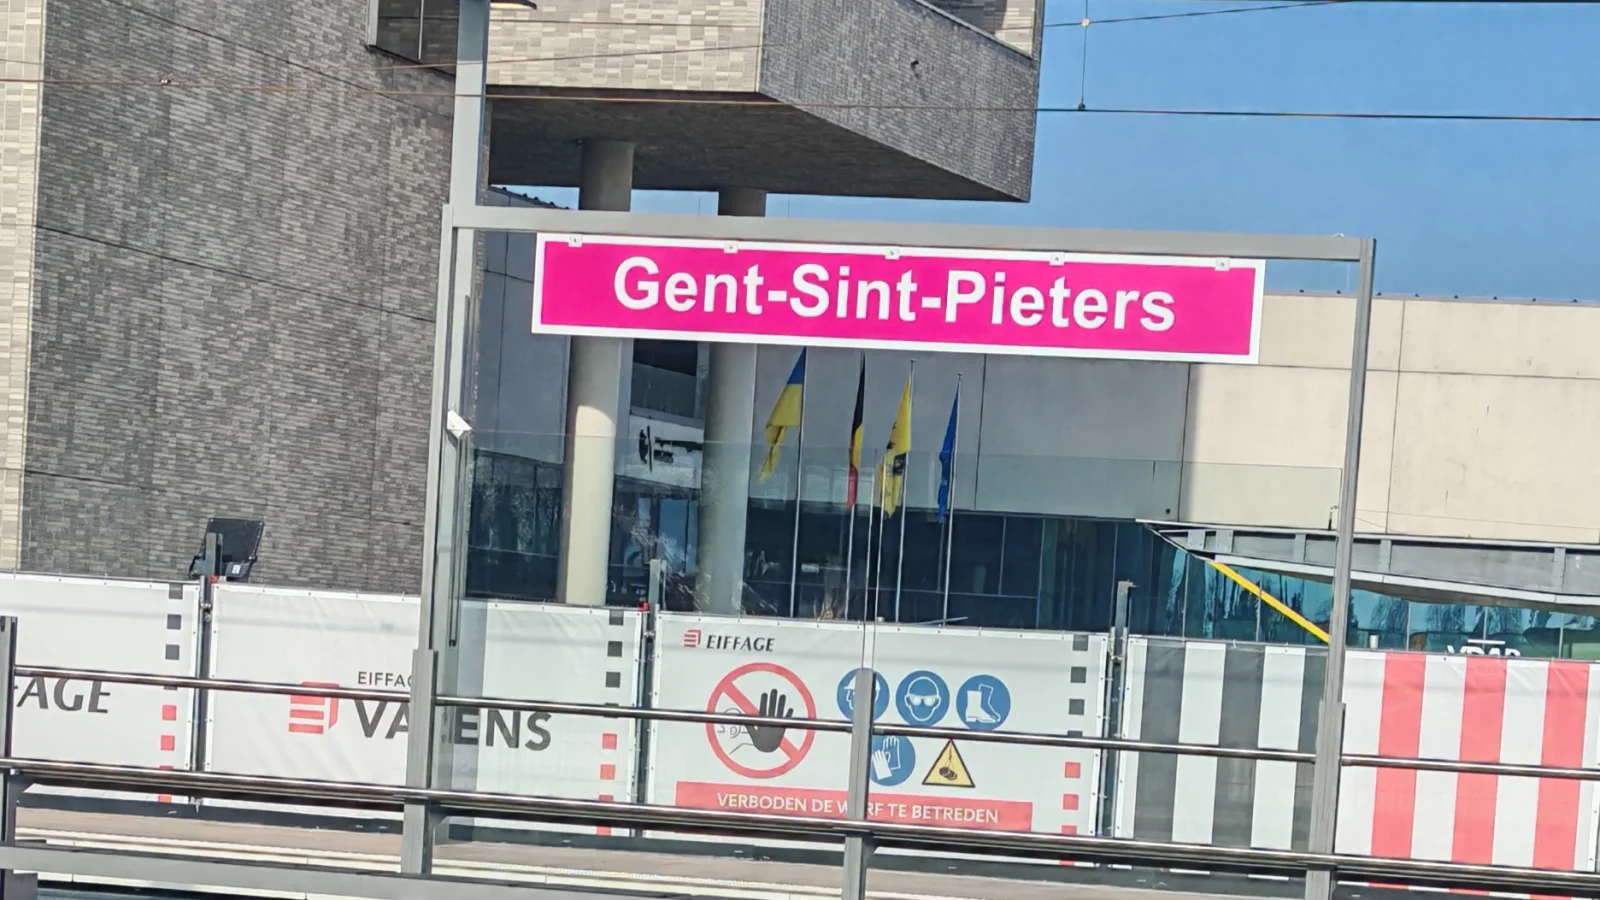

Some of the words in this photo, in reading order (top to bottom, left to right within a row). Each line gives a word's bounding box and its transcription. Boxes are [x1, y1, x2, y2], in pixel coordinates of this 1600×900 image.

[614, 256, 1175, 331] Gent-Sint-Pieters
[706, 634, 775, 652] EIFFAGE
[14, 676, 110, 713] AGE
[357, 671, 412, 687] EIFFA
[354, 698, 552, 751] VAENS
[717, 793, 806, 811] VERBODEN
[811, 799, 833, 813] DE
[837, 800, 884, 817] WRF
[887, 803, 907, 818] TE
[911, 805, 998, 823] BETREDEN
